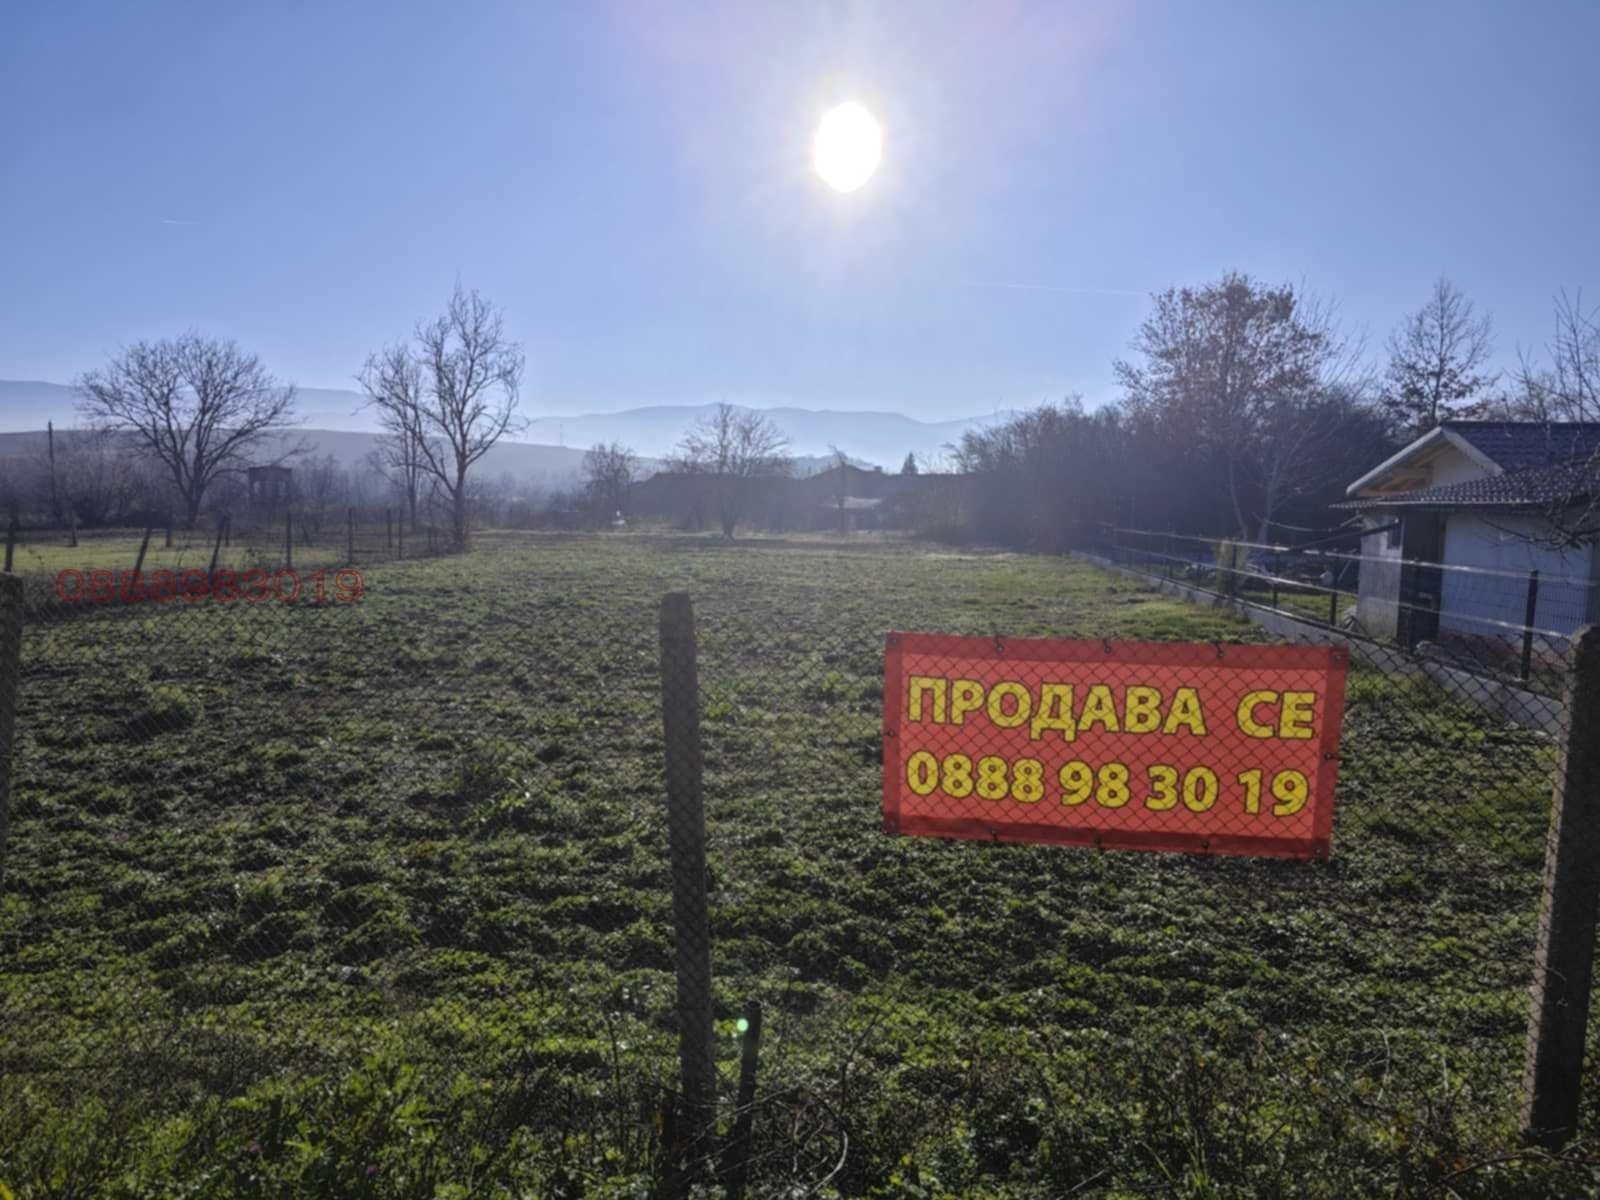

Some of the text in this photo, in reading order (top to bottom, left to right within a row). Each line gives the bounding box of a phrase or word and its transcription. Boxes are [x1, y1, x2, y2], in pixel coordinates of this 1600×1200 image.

[908, 675, 1317, 742] ПРОДАВА СЕ
[906, 751, 1310, 817] 0888 98 30 19
